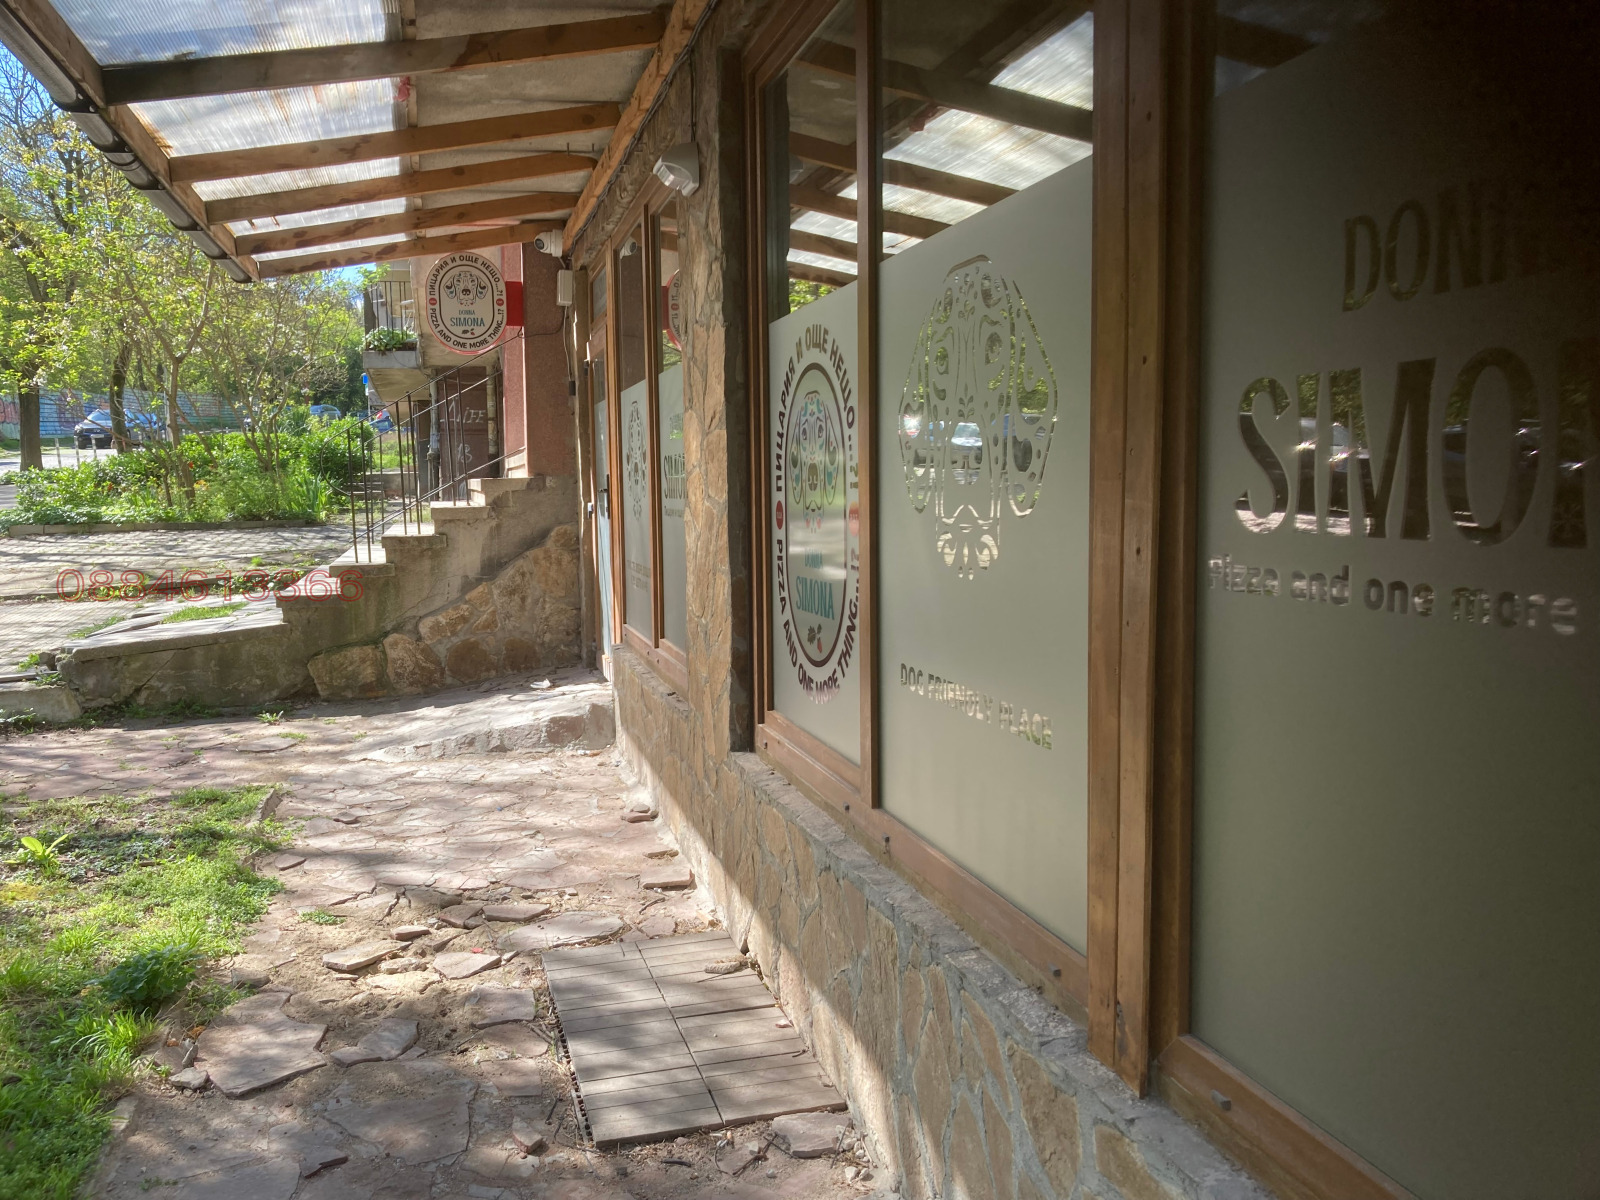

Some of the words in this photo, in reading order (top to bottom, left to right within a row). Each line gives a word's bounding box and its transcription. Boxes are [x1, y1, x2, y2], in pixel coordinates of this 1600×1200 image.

[429, 260, 449, 295] ПИЦАРИЯ
[450, 256, 457, 264] И
[459, 254, 480, 264] ОЩЕ
[430, 308, 440, 329] PIZZA
[437, 329, 451, 343] AND
[452, 340, 467, 349] ONE
[469, 338, 489, 349] MORE
[450, 317, 485, 327] SIMONA
[776, 356, 795, 492] ПИЦАРИЯ
[795, 336, 803, 364] И
[805, 324, 829, 354] ОЩЕ
[776, 539, 787, 615] PIZZA
[783, 619, 798, 667] AND
[798, 663, 814, 701] ONE
[815, 668, 840, 704] MORE
[796, 575, 835, 620] SIMONA
[1290, 564, 1350, 607] and
[1363, 577, 1435, 617] one
[1451, 585, 1578, 636] more
[928, 673, 994, 724] FRIENDLY
[999, 701, 1053, 750] PLACE
